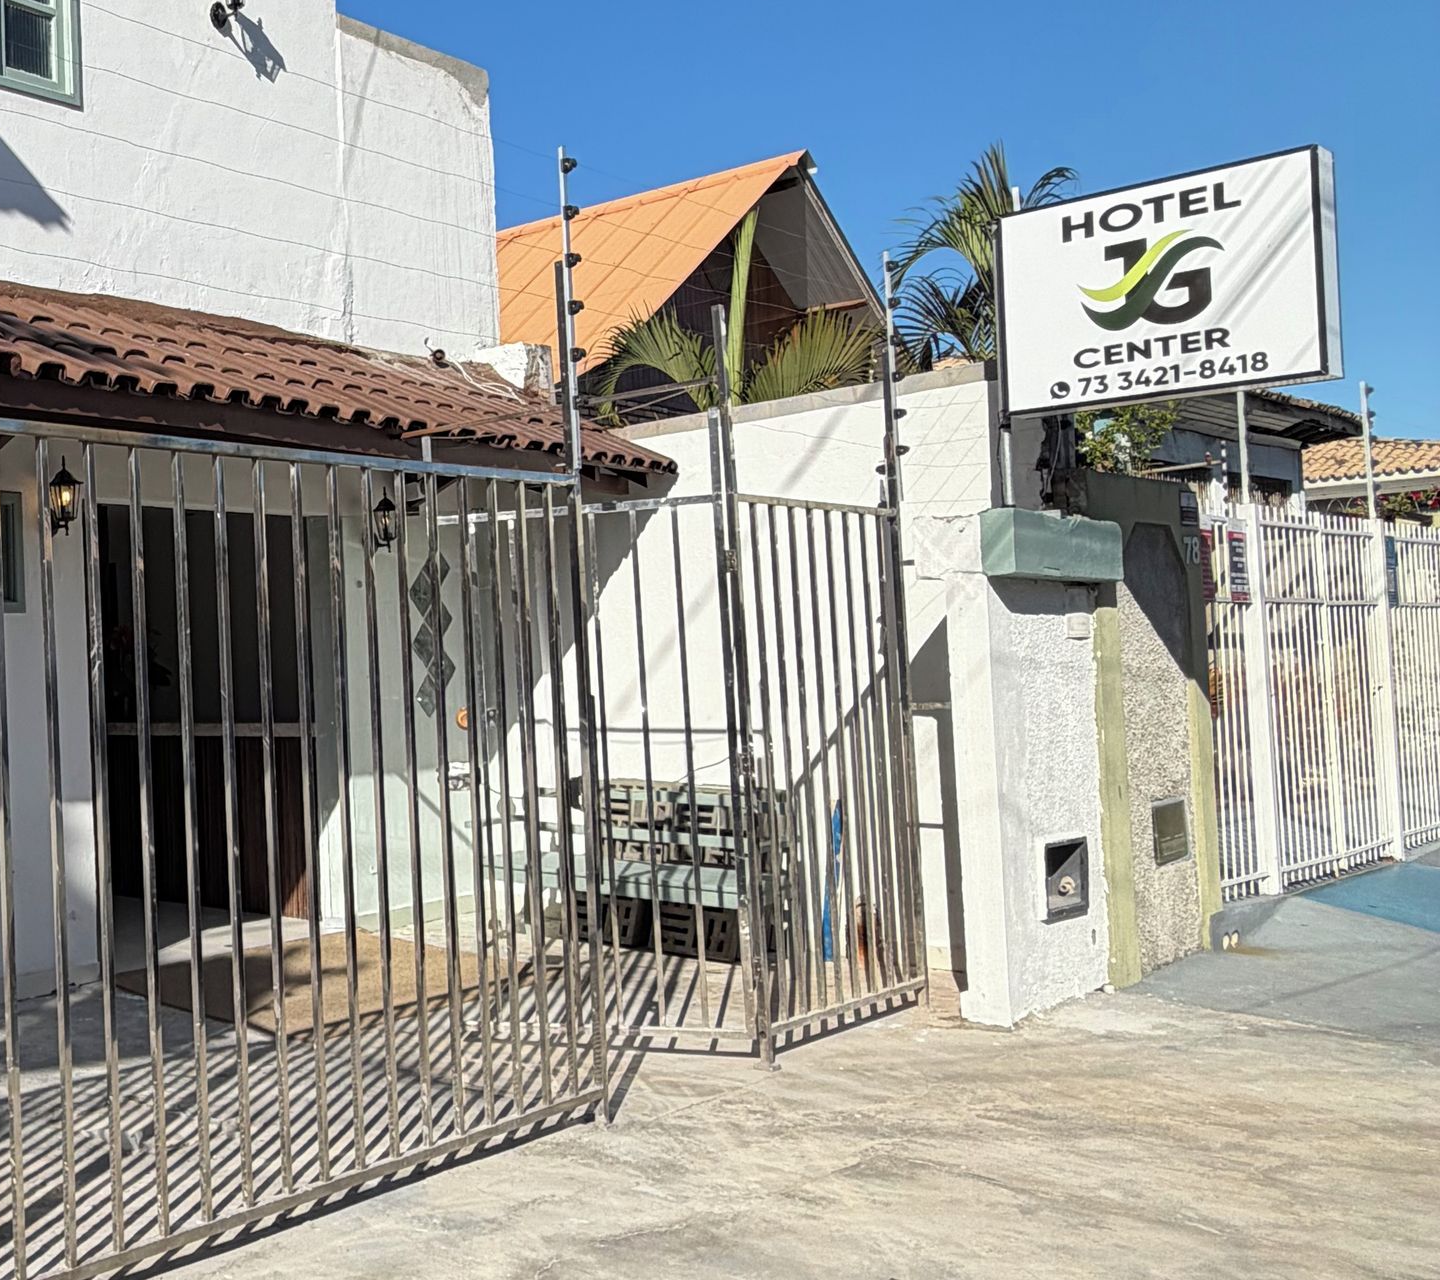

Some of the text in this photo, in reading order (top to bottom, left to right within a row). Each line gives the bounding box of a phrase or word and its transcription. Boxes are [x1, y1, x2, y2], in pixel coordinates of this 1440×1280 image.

[1062, 182, 1241, 243] HOTEL
[1073, 328, 1230, 369] CENTER
[1078, 352, 1269, 397] 73 3421-8418
[1183, 536, 1200, 565] 78
